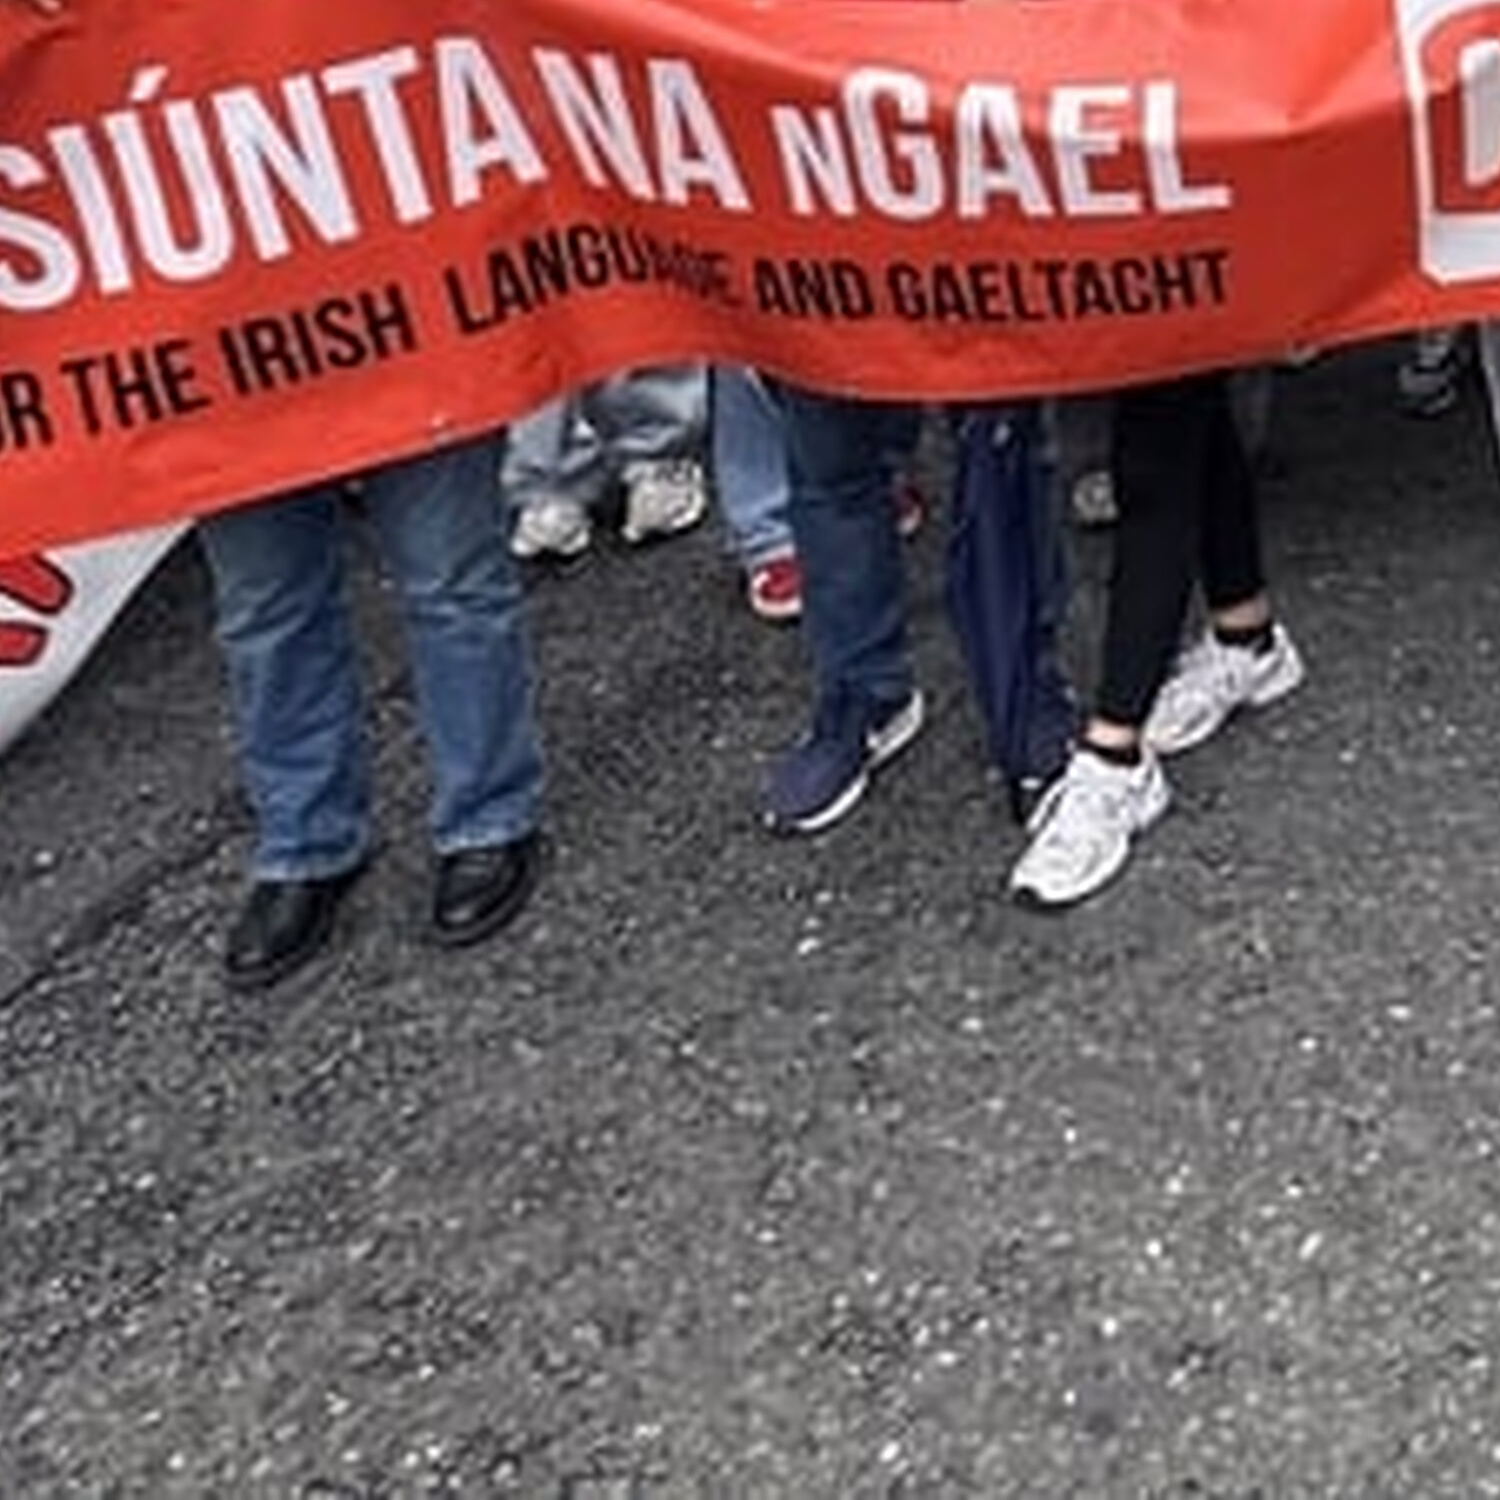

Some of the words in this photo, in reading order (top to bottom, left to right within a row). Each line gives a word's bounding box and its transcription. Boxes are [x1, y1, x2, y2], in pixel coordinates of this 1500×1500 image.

[0, 37, 548, 311] SIÚNTA
[532, 46, 752, 212] NA
[0, 372, 54, 453] R
[59, 340, 210, 435] THE
[218, 284, 419, 396] IRISH
[755, 256, 874, 320] AND
[887, 250, 1230, 322] GAELTACHT
